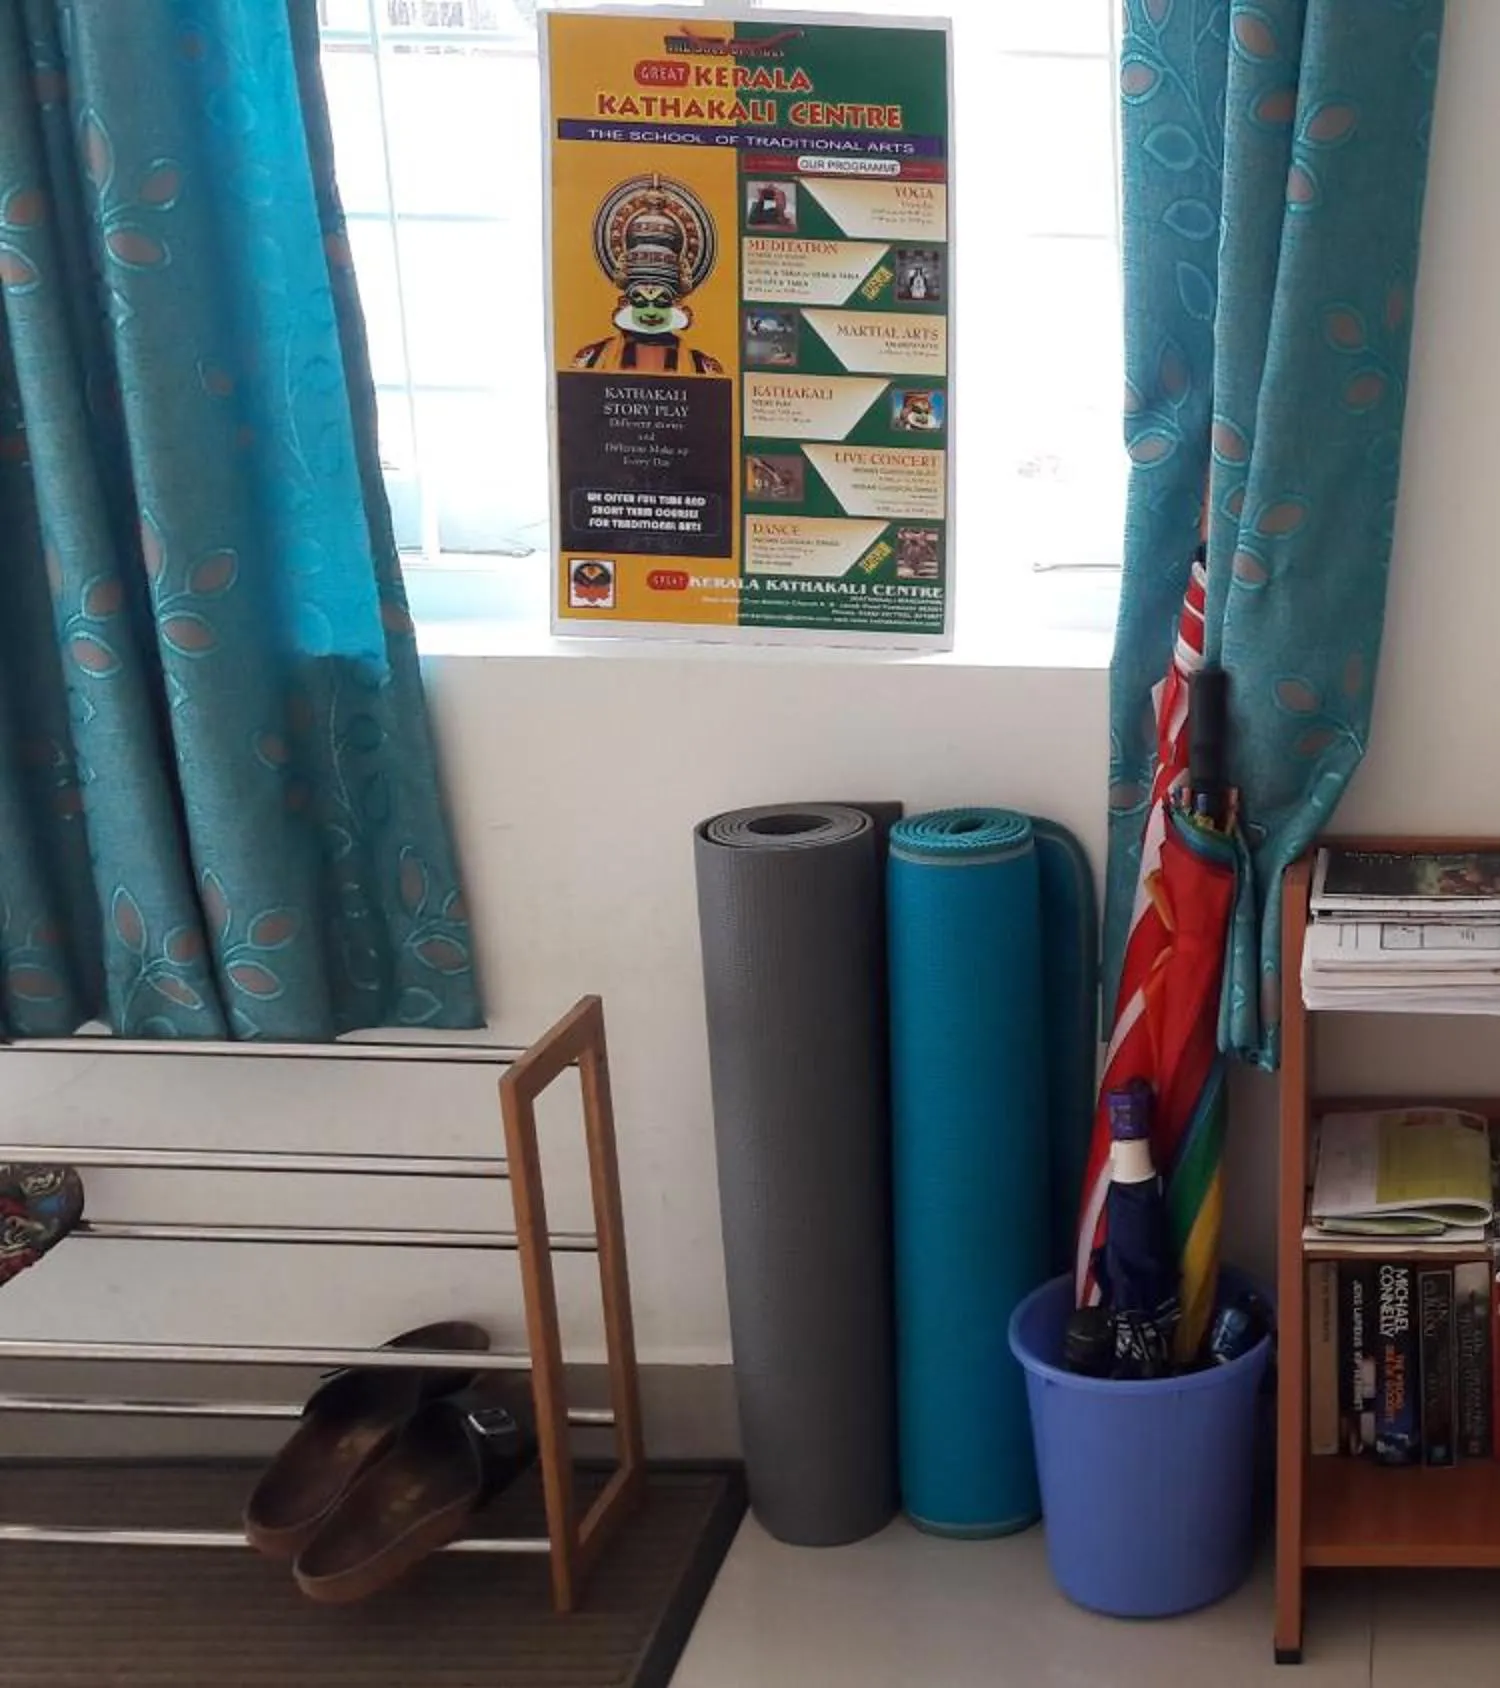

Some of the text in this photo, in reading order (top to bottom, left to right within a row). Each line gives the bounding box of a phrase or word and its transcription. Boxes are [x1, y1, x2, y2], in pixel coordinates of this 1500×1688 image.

[640, 65, 814, 93] GREAT KERALA
[597, 93, 904, 130] KATHAKALI CENTRE
[587, 128, 916, 155] THE SCHOOL OF TRADITIONAL ARTS
[800, 159, 899, 173] OUR PROGRAMME
[894, 185, 934, 199] YOGA
[747, 239, 839, 255] MEDITATION
[836, 324, 939, 341] MARTIAL ARTS
[604, 387, 687, 401] KATHAKALI
[752, 384, 833, 400] KATHAKALI
[603, 403, 690, 417] STORY PLAY
[609, 418, 653, 429] Different
[834, 452, 938, 468] LIVE CONCERT
[587, 492, 602, 503] WE
[604, 493, 636, 504] OFFER
[658, 495, 683, 506] TIME
[591, 505, 700, 520] SHORT TERM COURSES
[588, 518, 702, 532] FOR TRADITIONAL ARTS
[752, 523, 801, 536] DANCE
[687, 576, 759, 591] KERALA
[765, 579, 867, 596] KATHAKALI
[872, 584, 945, 598] CENTRE
[1379, 1264, 1395, 1338] CONNELLY
[1396, 1268, 1409, 1333] MICHAEL
